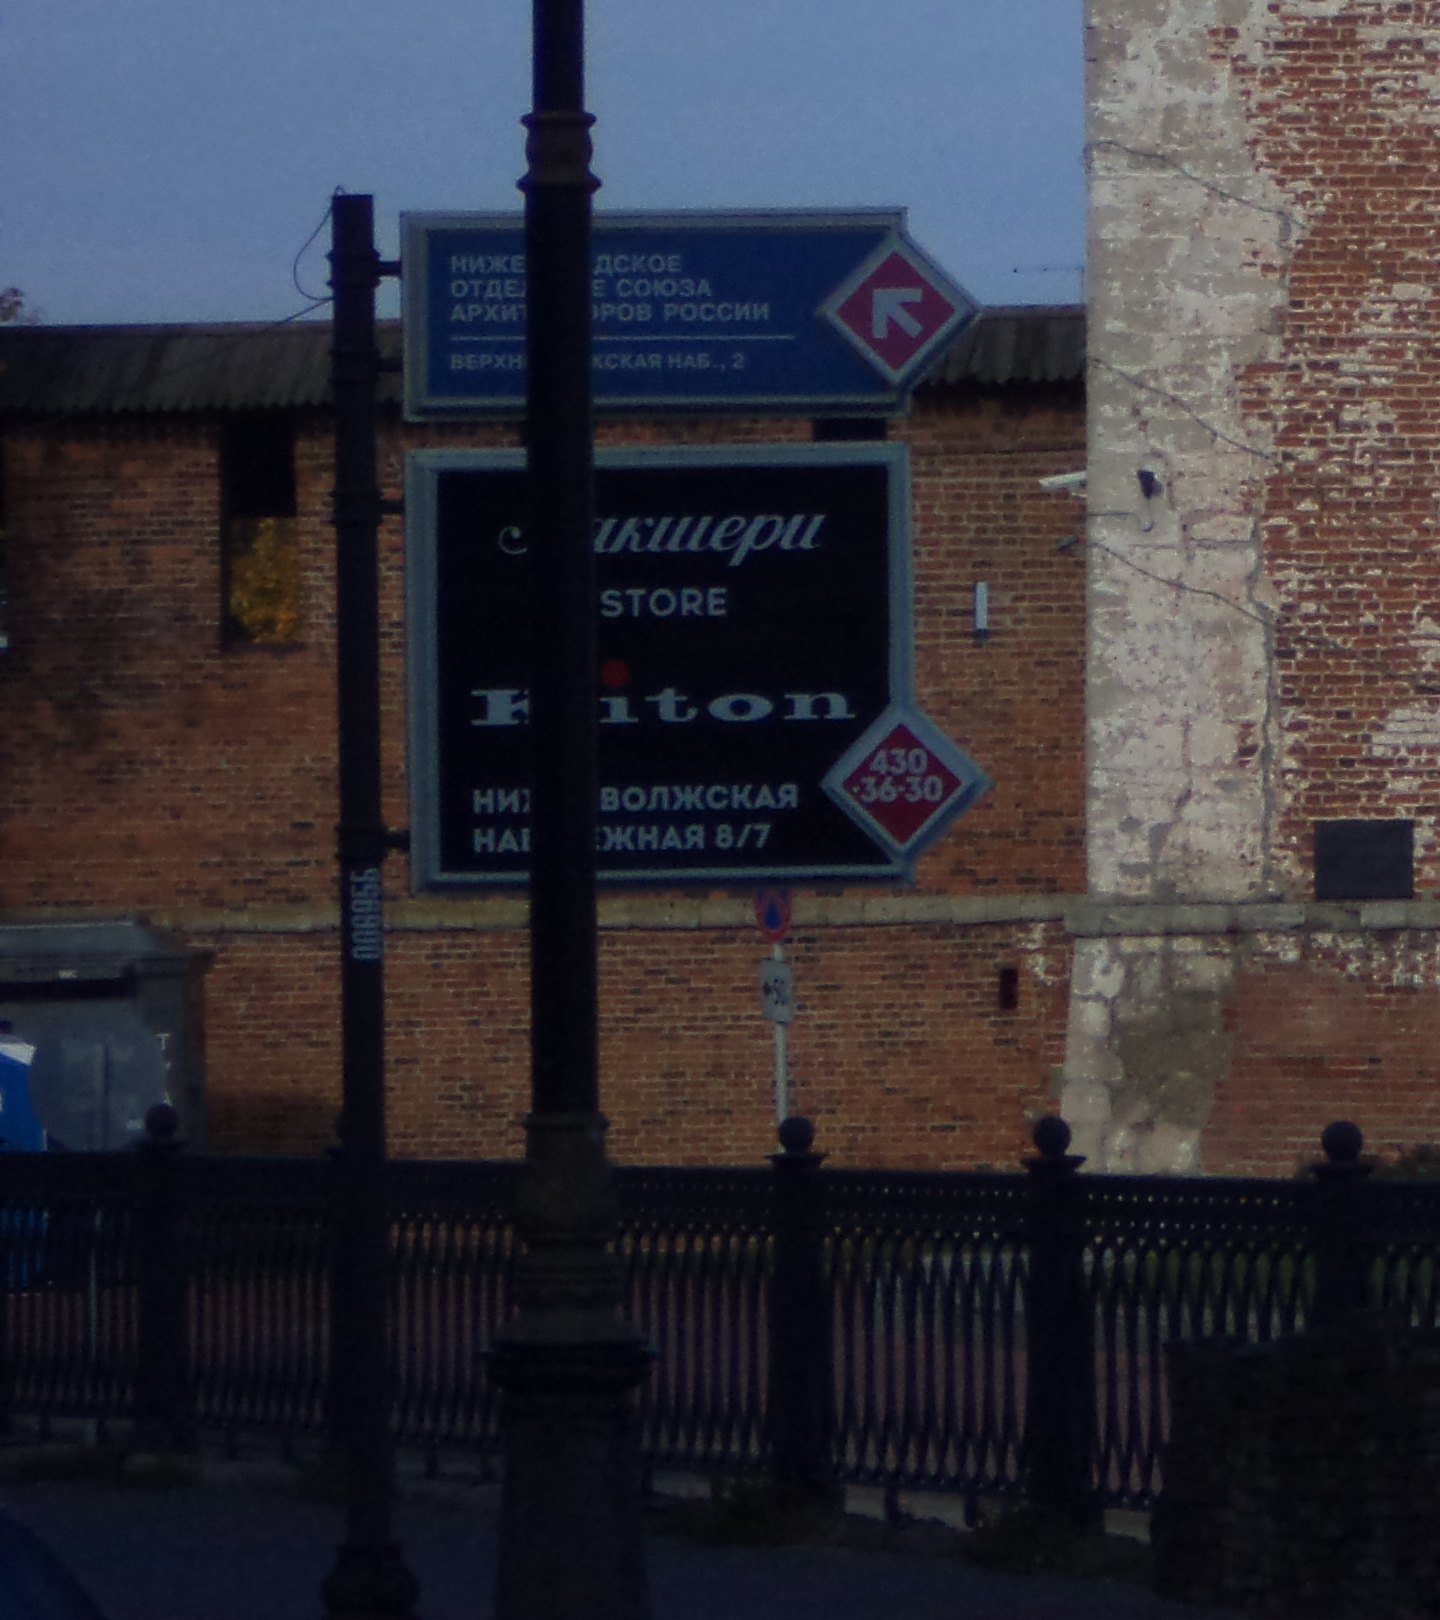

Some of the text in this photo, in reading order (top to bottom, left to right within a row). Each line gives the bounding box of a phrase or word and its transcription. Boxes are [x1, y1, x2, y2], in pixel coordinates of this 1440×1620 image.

[450, 254, 683, 277] НИЖЕДСКОЕ
[450, 278, 713, 300] ОТДЕЕ СОЮЗА
[450, 302, 771, 322] АРХИРОВ РОССИИ
[450, 353, 662, 370] ВЕРХНСКАЯ
[732, 353, 746, 369] 2
[599, 586, 728, 618] STORE
[869, 747, 928, 775] 430
[472, 782, 800, 814] НИВОЛЖСКАЯ
[472, 822, 772, 854] НАЖНАЯ 8/7
